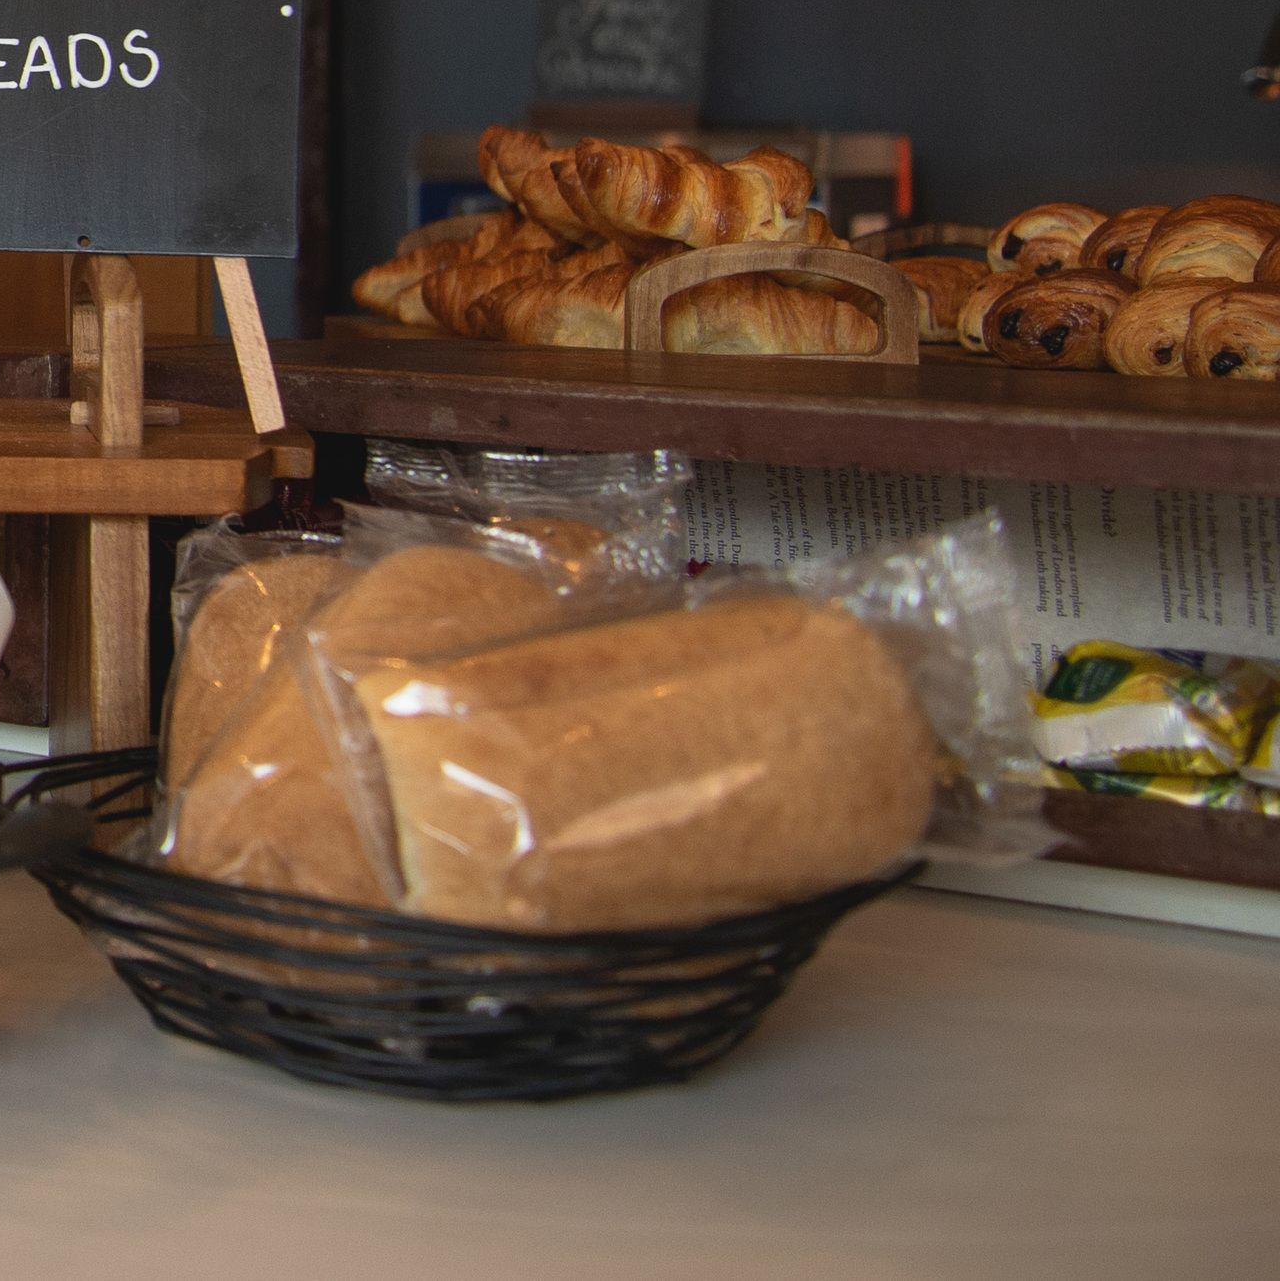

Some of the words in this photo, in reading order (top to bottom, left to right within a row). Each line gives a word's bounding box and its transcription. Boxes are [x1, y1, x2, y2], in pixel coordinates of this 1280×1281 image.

[696, 473, 707, 494] chip
[726, 486, 735, 495] in
[766, 478, 776, 488] in
[782, 488, 794, 499] of
[824, 481, 834, 504] from
[796, 486, 809, 526] advocate
[854, 481, 866, 519] Dickens
[900, 475, 912, 519] American
[712, 489, 722, 504] the
[717, 540, 728, 559] that
[728, 498, 741, 541] Scotland,
[769, 502, 782, 524] Tale
[780, 501, 796, 542] potatoes,
[1030, 491, 1044, 548] Manchester
[1155, 499, 1169, 549] affordable
[689, 527, 698, 536] in
[702, 521, 713, 540] first
[773, 525, 785, 538] of
[802, 528, 814, 541] of
[826, 508, 840, 549] Belgium.
[1046, 511, 1061, 543] family
[1062, 514, 1077, 553] together
[689, 540, 700, 555] the
[703, 543, 714, 562] sold
[773, 538, 781, 556] two
[803, 541, 815, 557] the
[1052, 544, 1064, 558] of
[1035, 550, 1049, 573] both
[1069, 555, 1076, 565] as
[1159, 551, 1172, 571] and
[1052, 558, 1066, 596] London
[1194, 554, 1208, 606] revolution
[1212, 572, 1224, 589] but
[1246, 571, 1259, 600] world
[1036, 575, 1051, 613] staking
[1069, 574, 1084, 618] complete
[1160, 573, 1174, 623] nutritious
[1214, 591, 1222, 607] are
[1055, 598, 1069, 617] and
[1178, 593, 1192, 619] huge
[1197, 608, 1210, 622] of
[1214, 609, 1223, 626] are
